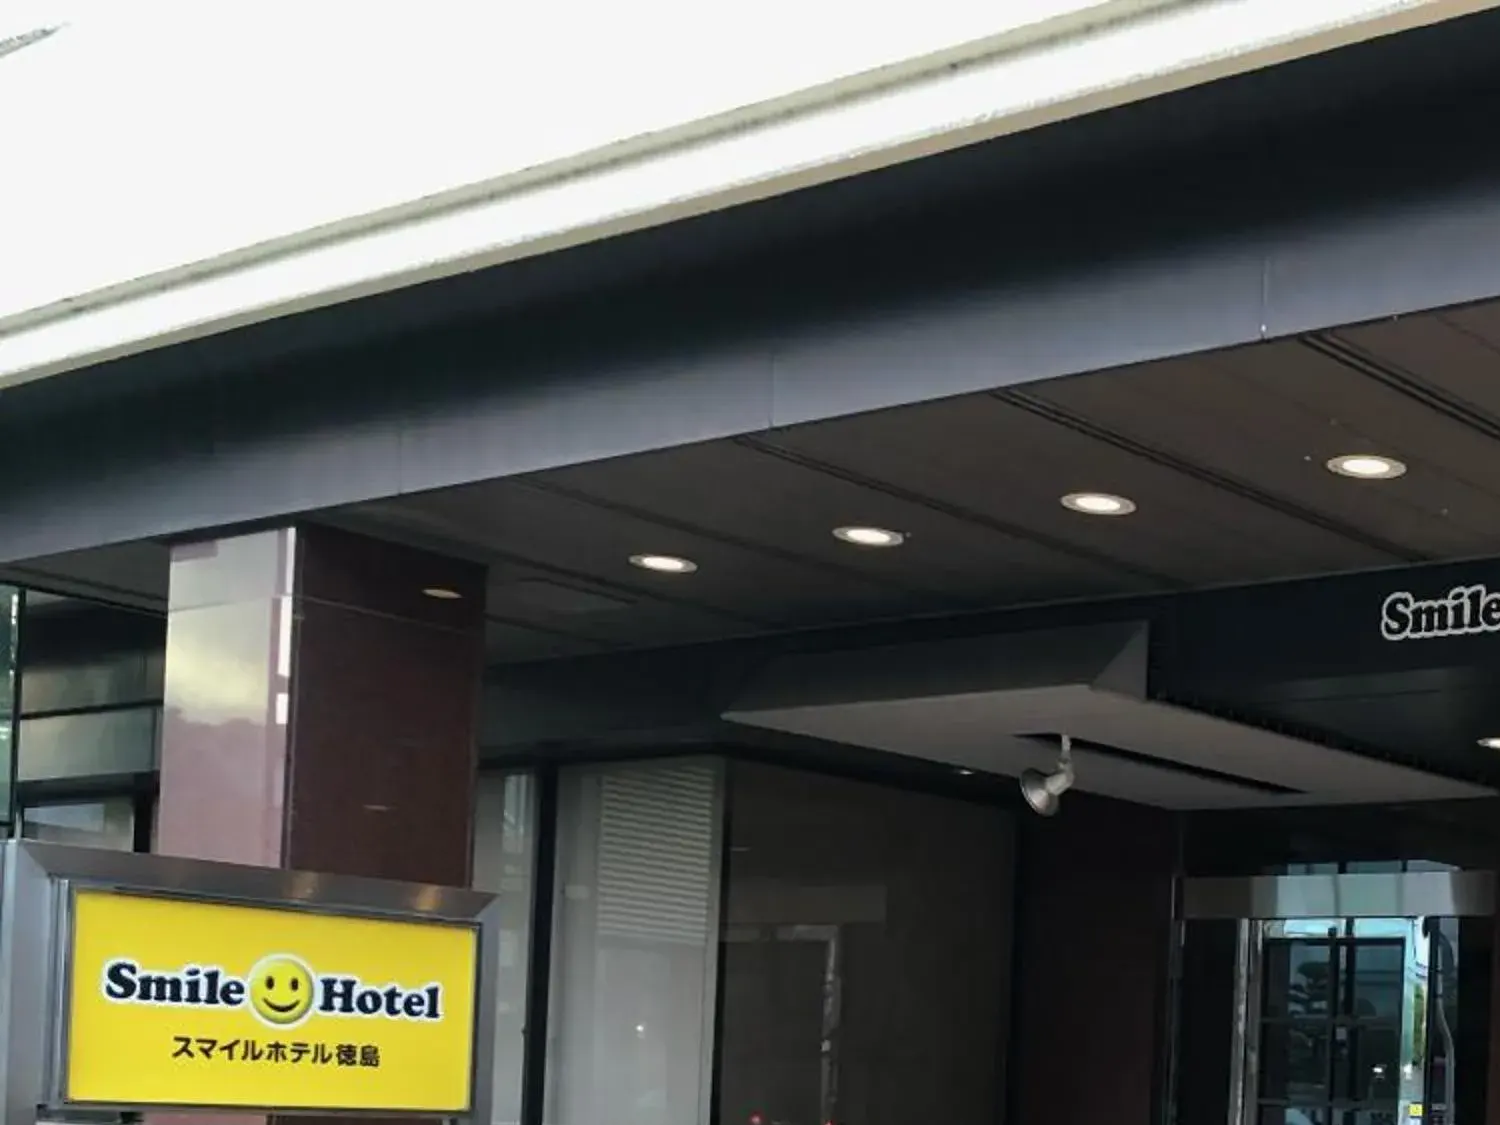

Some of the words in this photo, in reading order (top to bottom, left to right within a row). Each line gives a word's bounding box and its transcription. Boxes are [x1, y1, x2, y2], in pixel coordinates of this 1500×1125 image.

[103, 960, 246, 1007] Smile
[319, 977, 442, 1019] Hotel
[172, 1036, 381, 1067] スマイルホテル徳島
